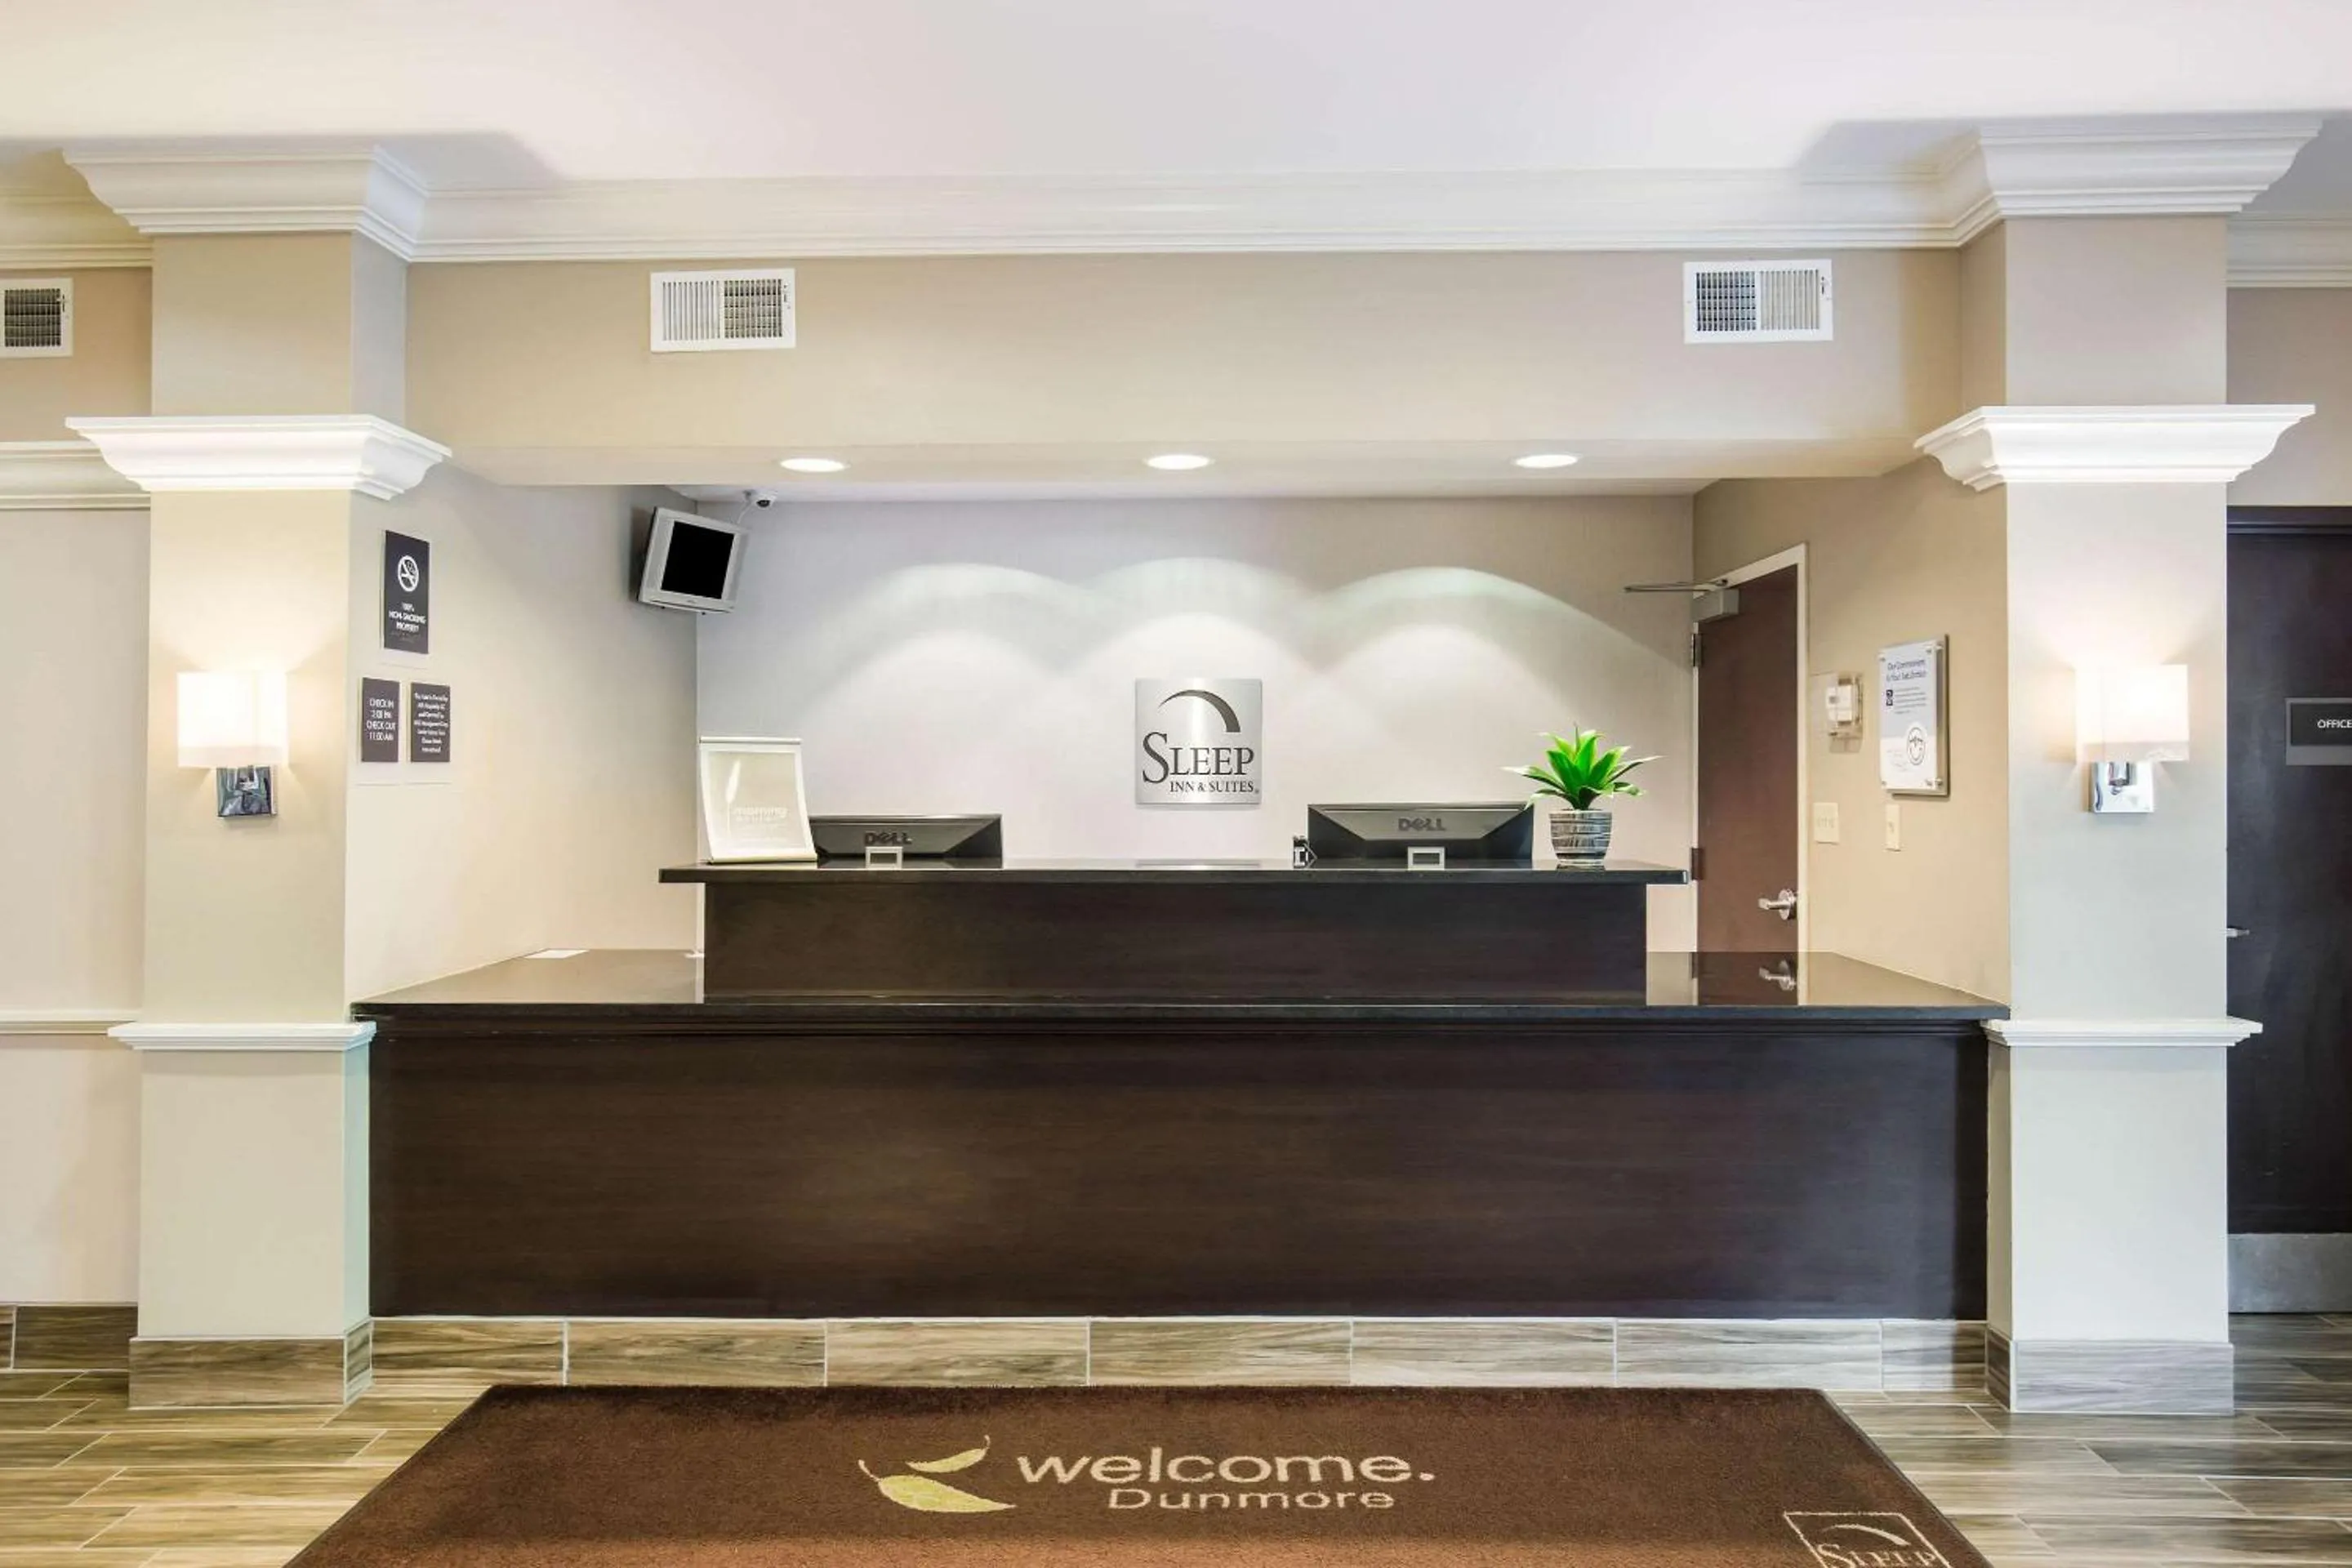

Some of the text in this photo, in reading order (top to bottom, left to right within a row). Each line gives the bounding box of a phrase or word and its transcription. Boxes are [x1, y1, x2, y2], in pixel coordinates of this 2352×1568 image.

[366, 720, 396, 731] CHECK OUT
[2317, 719, 2352, 728] OFFICE
[1143, 732, 1254, 784] SLEEP
[1169, 781, 1254, 792] INN & SUITES
[1397, 818, 1446, 831] DELL
[863, 831, 913, 845] DELL
[1017, 1446, 1435, 1484] welcome.
[1108, 1488, 1394, 1509] Dunmore
